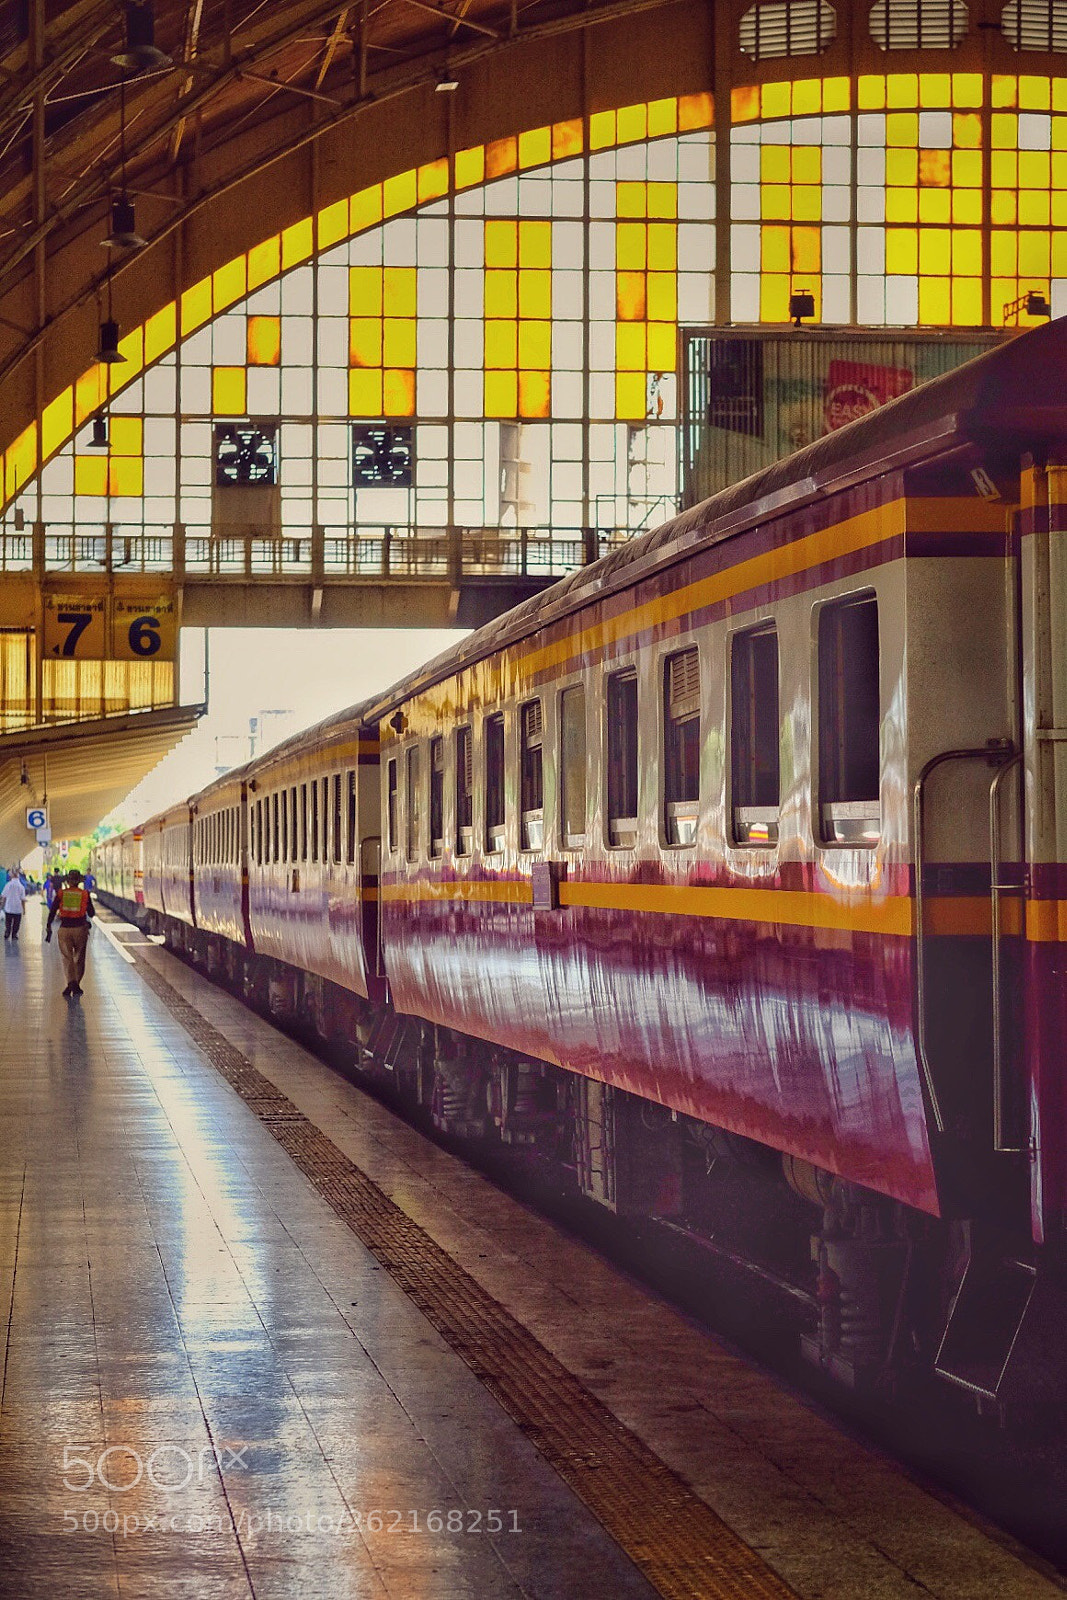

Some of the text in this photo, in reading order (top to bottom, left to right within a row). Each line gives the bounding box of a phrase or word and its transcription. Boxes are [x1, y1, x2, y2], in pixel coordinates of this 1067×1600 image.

[57, 613, 92, 656] 7
[128, 616, 161, 656] 6
[28, 810, 45, 828] 6
